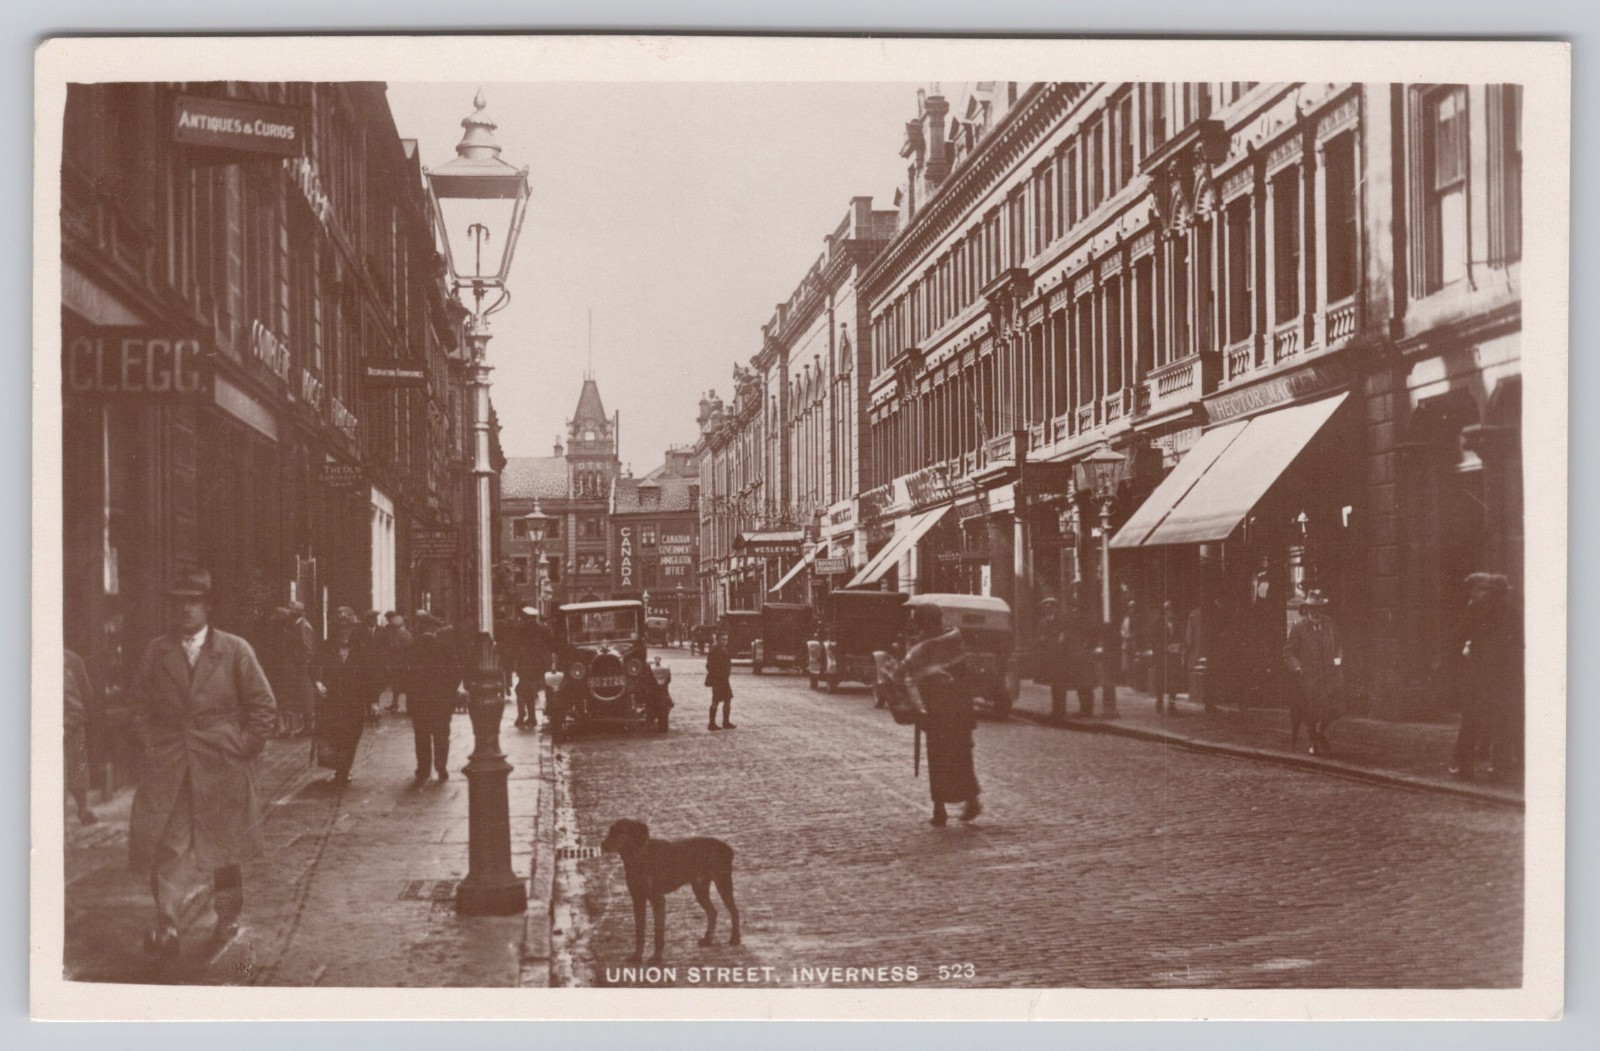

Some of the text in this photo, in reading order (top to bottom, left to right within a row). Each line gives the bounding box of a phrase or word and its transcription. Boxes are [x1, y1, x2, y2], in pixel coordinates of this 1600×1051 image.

[178, 110, 295, 140] ANTIQUES & CURIOS
[1214, 389, 1264, 419] HECTOR
[342, 465, 361, 474] OLD
[661, 534, 690, 544] CANADIAN
[658, 545, 692, 555] GOVERNMENT
[620, 527, 632, 587] CANADA
[664, 566, 685, 576] OFFICE
[647, 606, 670, 615] COAL
